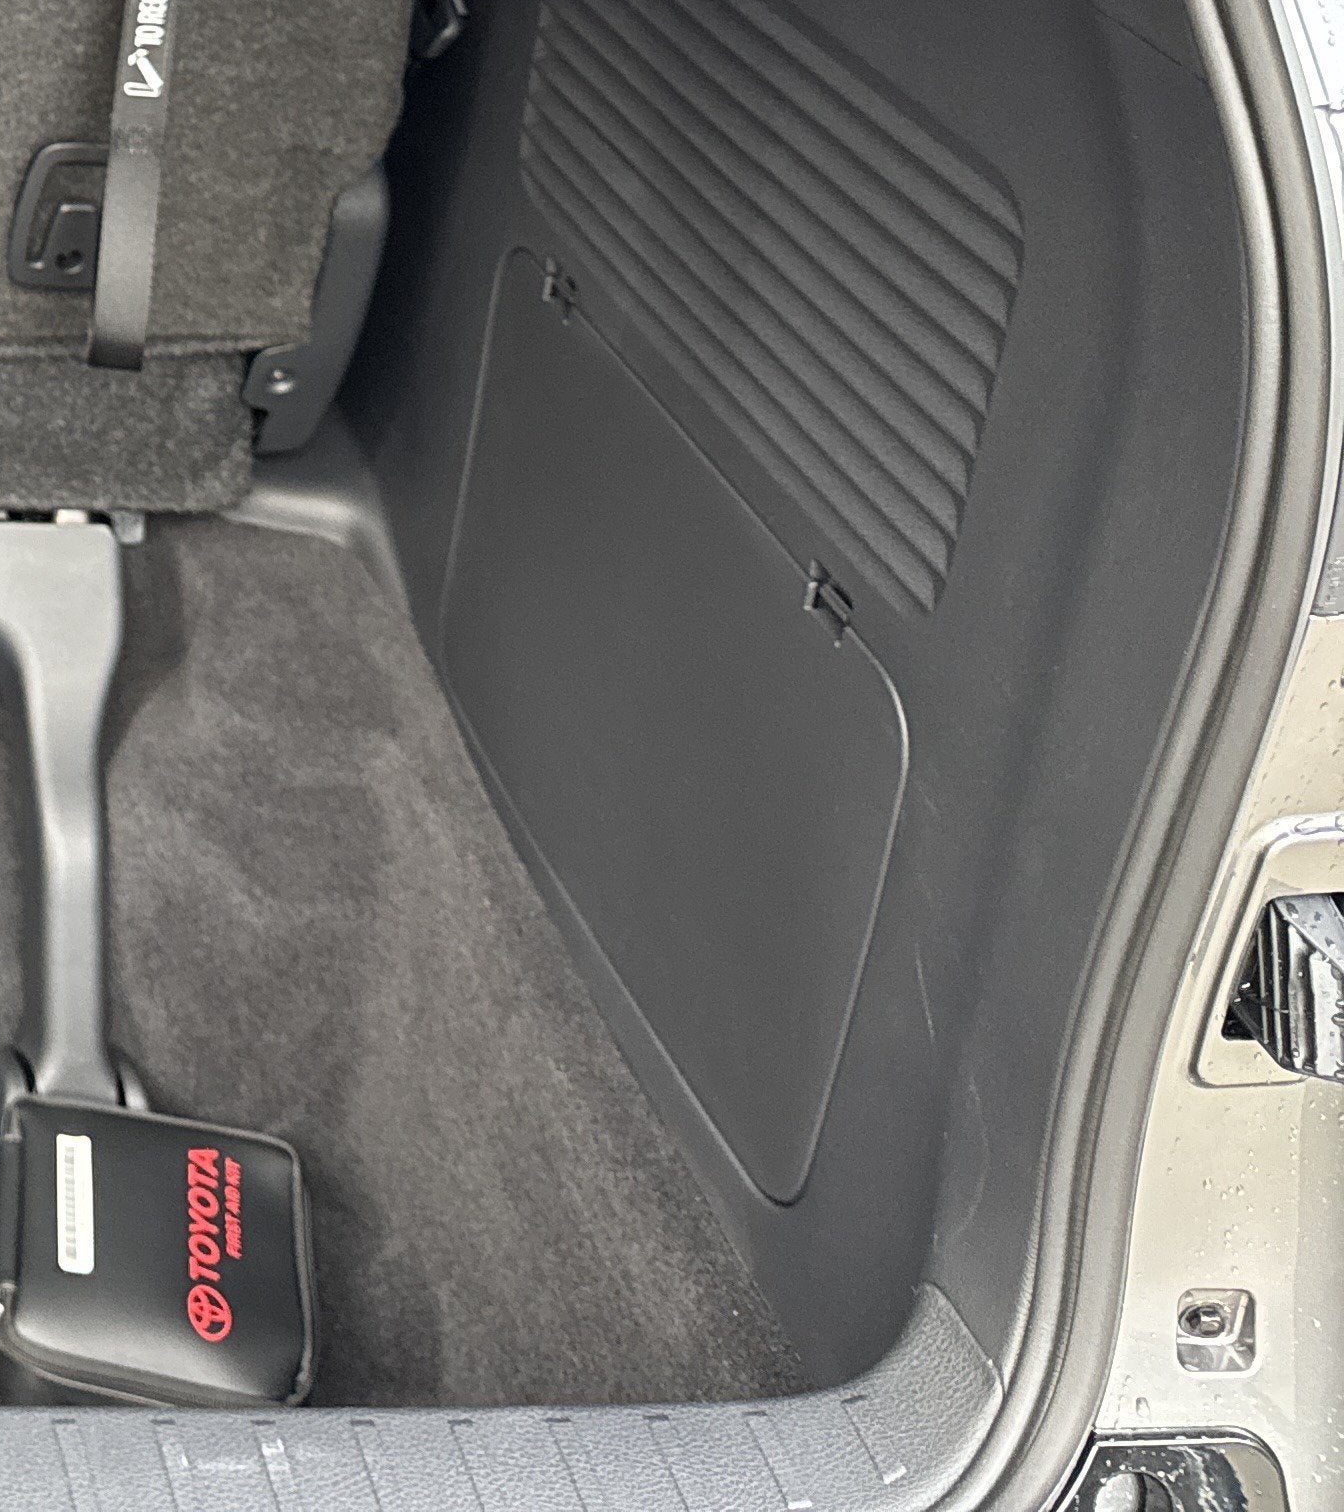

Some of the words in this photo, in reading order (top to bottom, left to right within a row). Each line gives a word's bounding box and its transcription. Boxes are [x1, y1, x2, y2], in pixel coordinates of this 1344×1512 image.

[134, 25, 165, 47] TO
[188, 1149, 221, 1282] TOYOTA
[224, 1185, 241, 1216] AID
[224, 1212, 243, 1260] FIRST
